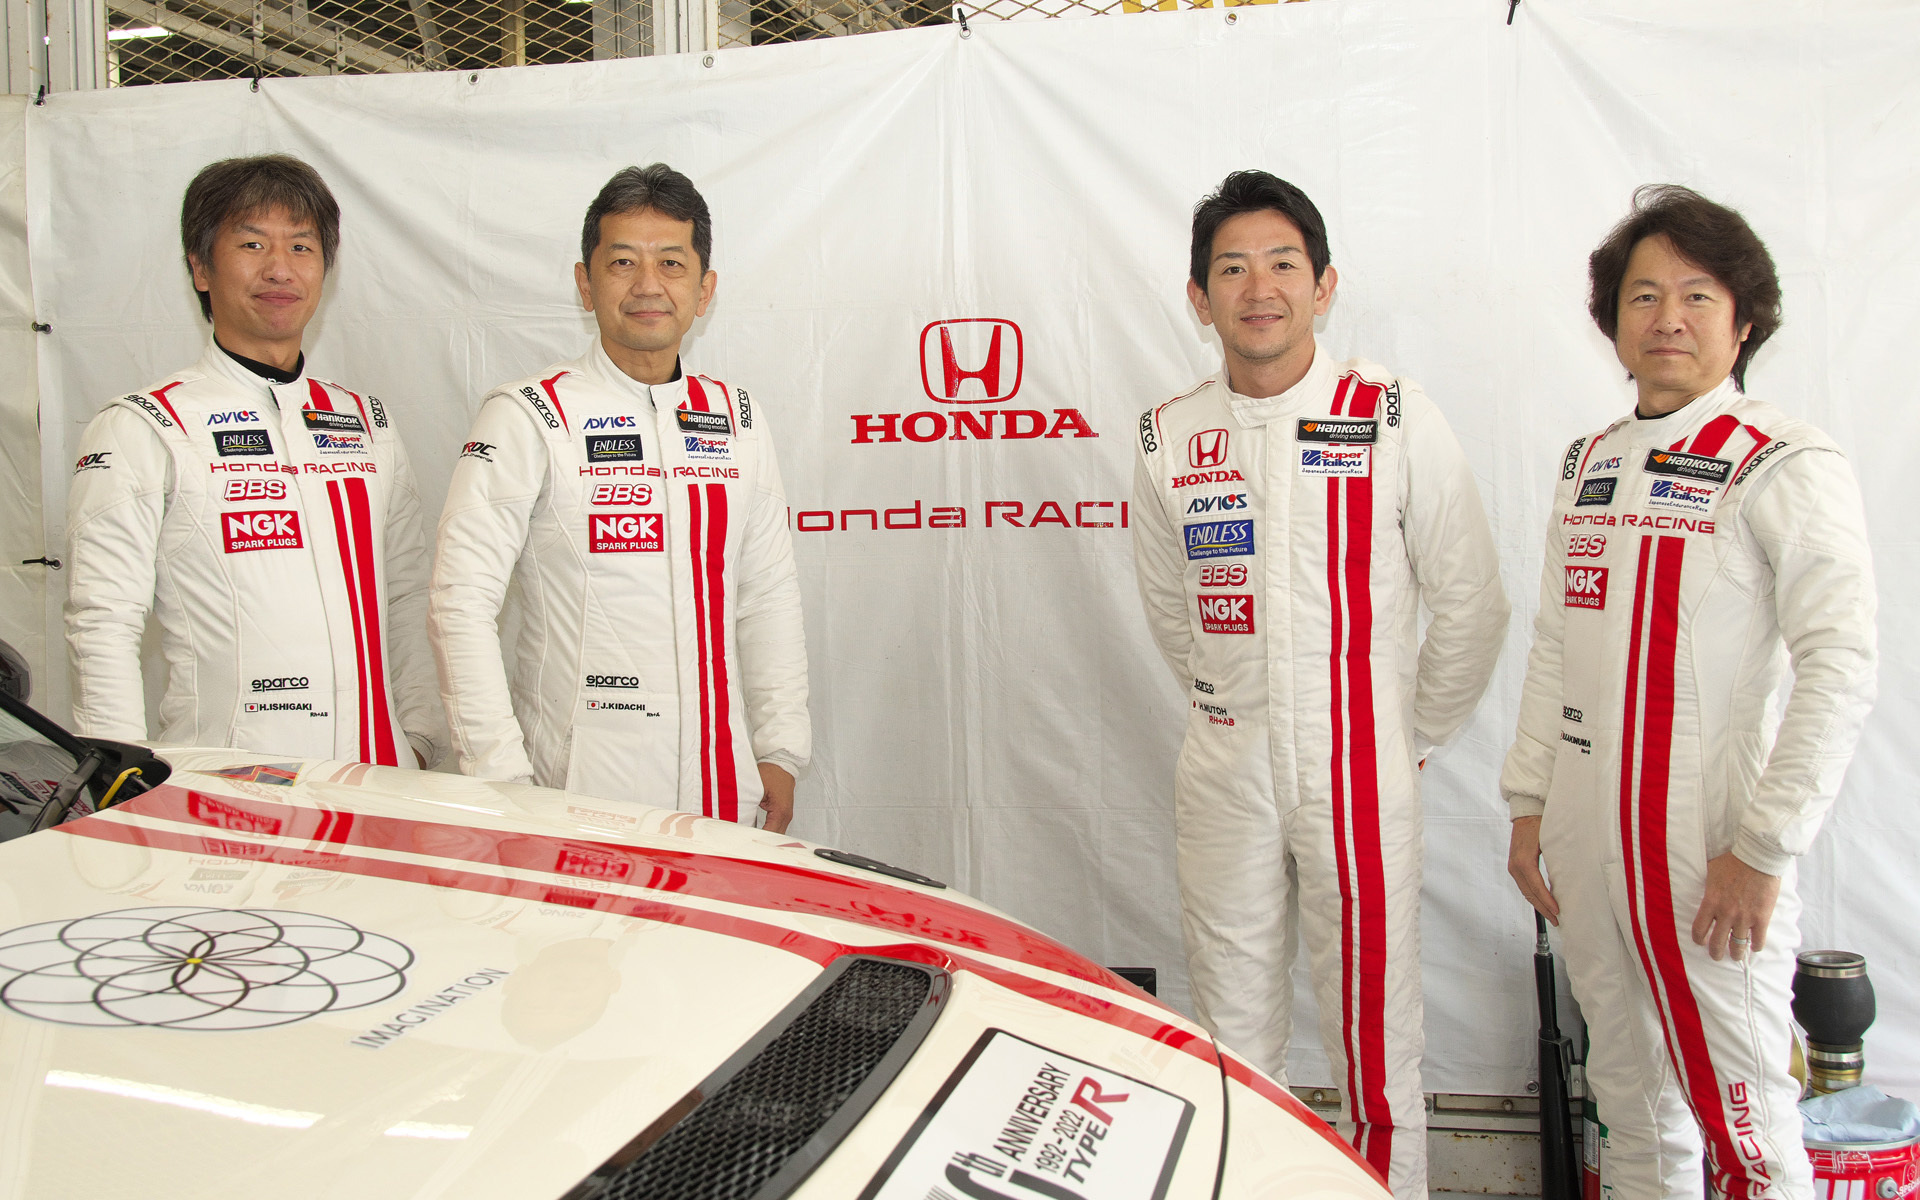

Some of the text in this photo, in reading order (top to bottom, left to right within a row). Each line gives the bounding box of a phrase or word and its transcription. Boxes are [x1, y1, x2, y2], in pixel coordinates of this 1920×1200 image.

[124, 394, 173, 428] sparco
[368, 395, 388, 429] sparco
[519, 385, 560, 430] sparco
[737, 388, 754, 430] sparco
[207, 410, 260, 426] ADVICS
[583, 416, 636, 430] ADVICS
[850, 409, 1100, 445] HONDA
[222, 434, 264, 447] ENDLESS
[328, 435, 361, 443] Super
[593, 439, 636, 452] ENDLESS
[698, 437, 728, 447] Super
[698, 445, 729, 454] Taikyu
[1321, 450, 1364, 461] Super
[1321, 458, 1362, 468] Taikyu
[1562, 437, 1587, 481] sparco
[1734, 441, 1790, 486] sparco
[303, 462, 377, 475] RACING
[673, 465, 739, 479] RACING
[1677, 465, 1722, 479] driving emotion
[1171, 470, 1245, 488] HONDA
[224, 479, 287, 502] BBS
[590, 483, 653, 506] BBS
[1669, 490, 1711, 505] Taikyu
[1671, 482, 1716, 497] Super
[1186, 492, 1248, 514] ADVICS
[787, 499, 967, 532] onda
[1563, 512, 1715, 534] Honda RACING
[228, 513, 296, 539] NGK
[596, 516, 658, 540] NGK
[1188, 521, 1249, 546] ENDLESS
[231, 538, 298, 551] SPARK PLUGS
[596, 541, 659, 551] SPARK PLUGS
[1190, 549, 1211, 559] Challenge
[1218, 547, 1229, 556] the
[1229, 546, 1248, 555] Future
[1567, 534, 1607, 559] BBS
[1199, 564, 1249, 587] BBS
[1565, 568, 1604, 596] NGK
[1199, 597, 1248, 622] NGK
[1578, 597, 1600, 607] PLUGS
[1204, 623, 1249, 633] SPARK PLUGS
[251, 676, 309, 693] sparco
[586, 674, 639, 689] sparco
[259, 703, 312, 711] H.ISHIGAKI
[600, 702, 646, 711] J.KIDACHI
[1209, 715, 1235, 727] RH+AB
[350, 967, 509, 1049] IMAGINATION
[992, 1062, 1071, 1162] ANNIVERSARY
[1062, 1076, 1130, 1184] TYPE R
